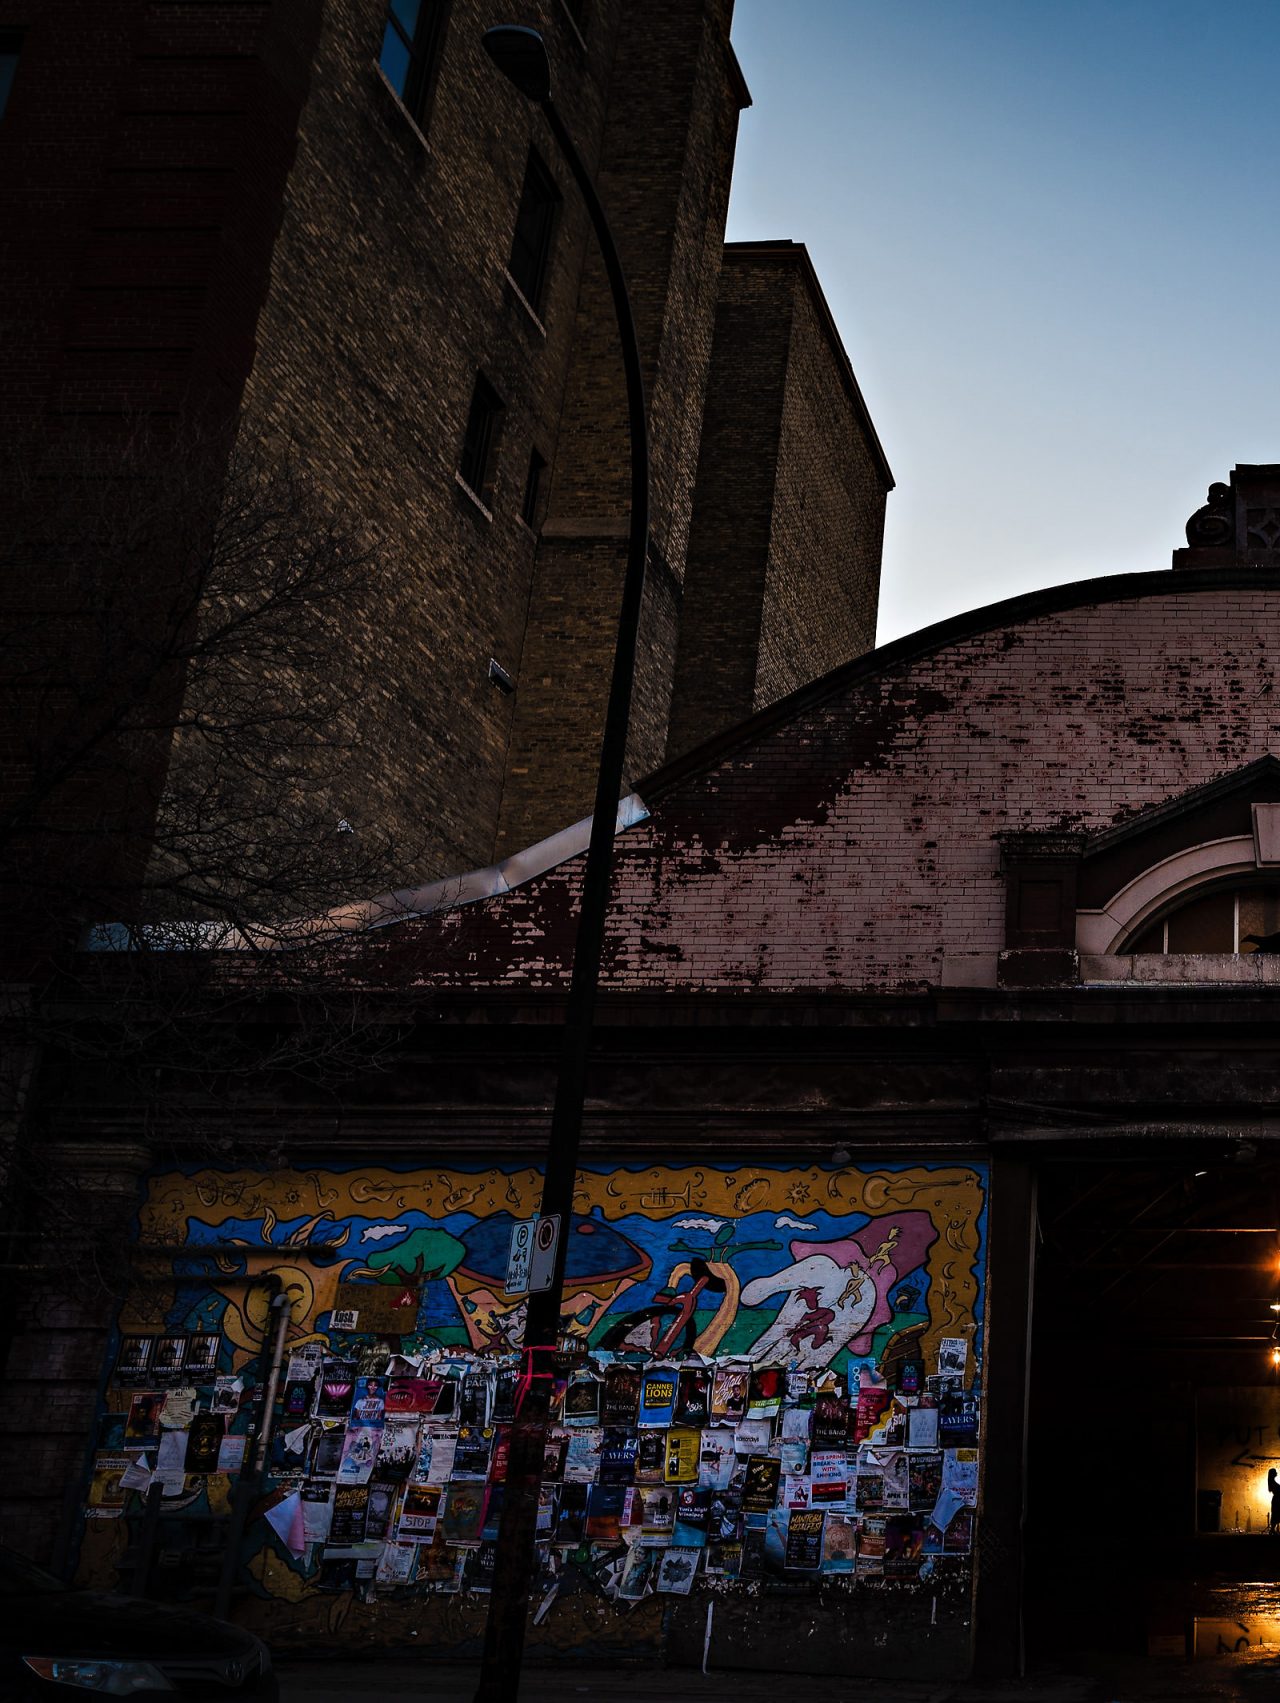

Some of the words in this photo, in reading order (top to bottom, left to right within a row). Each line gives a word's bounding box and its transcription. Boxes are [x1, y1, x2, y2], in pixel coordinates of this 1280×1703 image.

[645, 1389, 674, 1398] LIONS
[939, 1415, 975, 1426] LAYERS
[828, 1429, 847, 1437] BAND
[601, 1450, 637, 1461] LAYERS
[405, 1517, 432, 1527] STOP
[791, 1514, 822, 1524] MANITOBA
